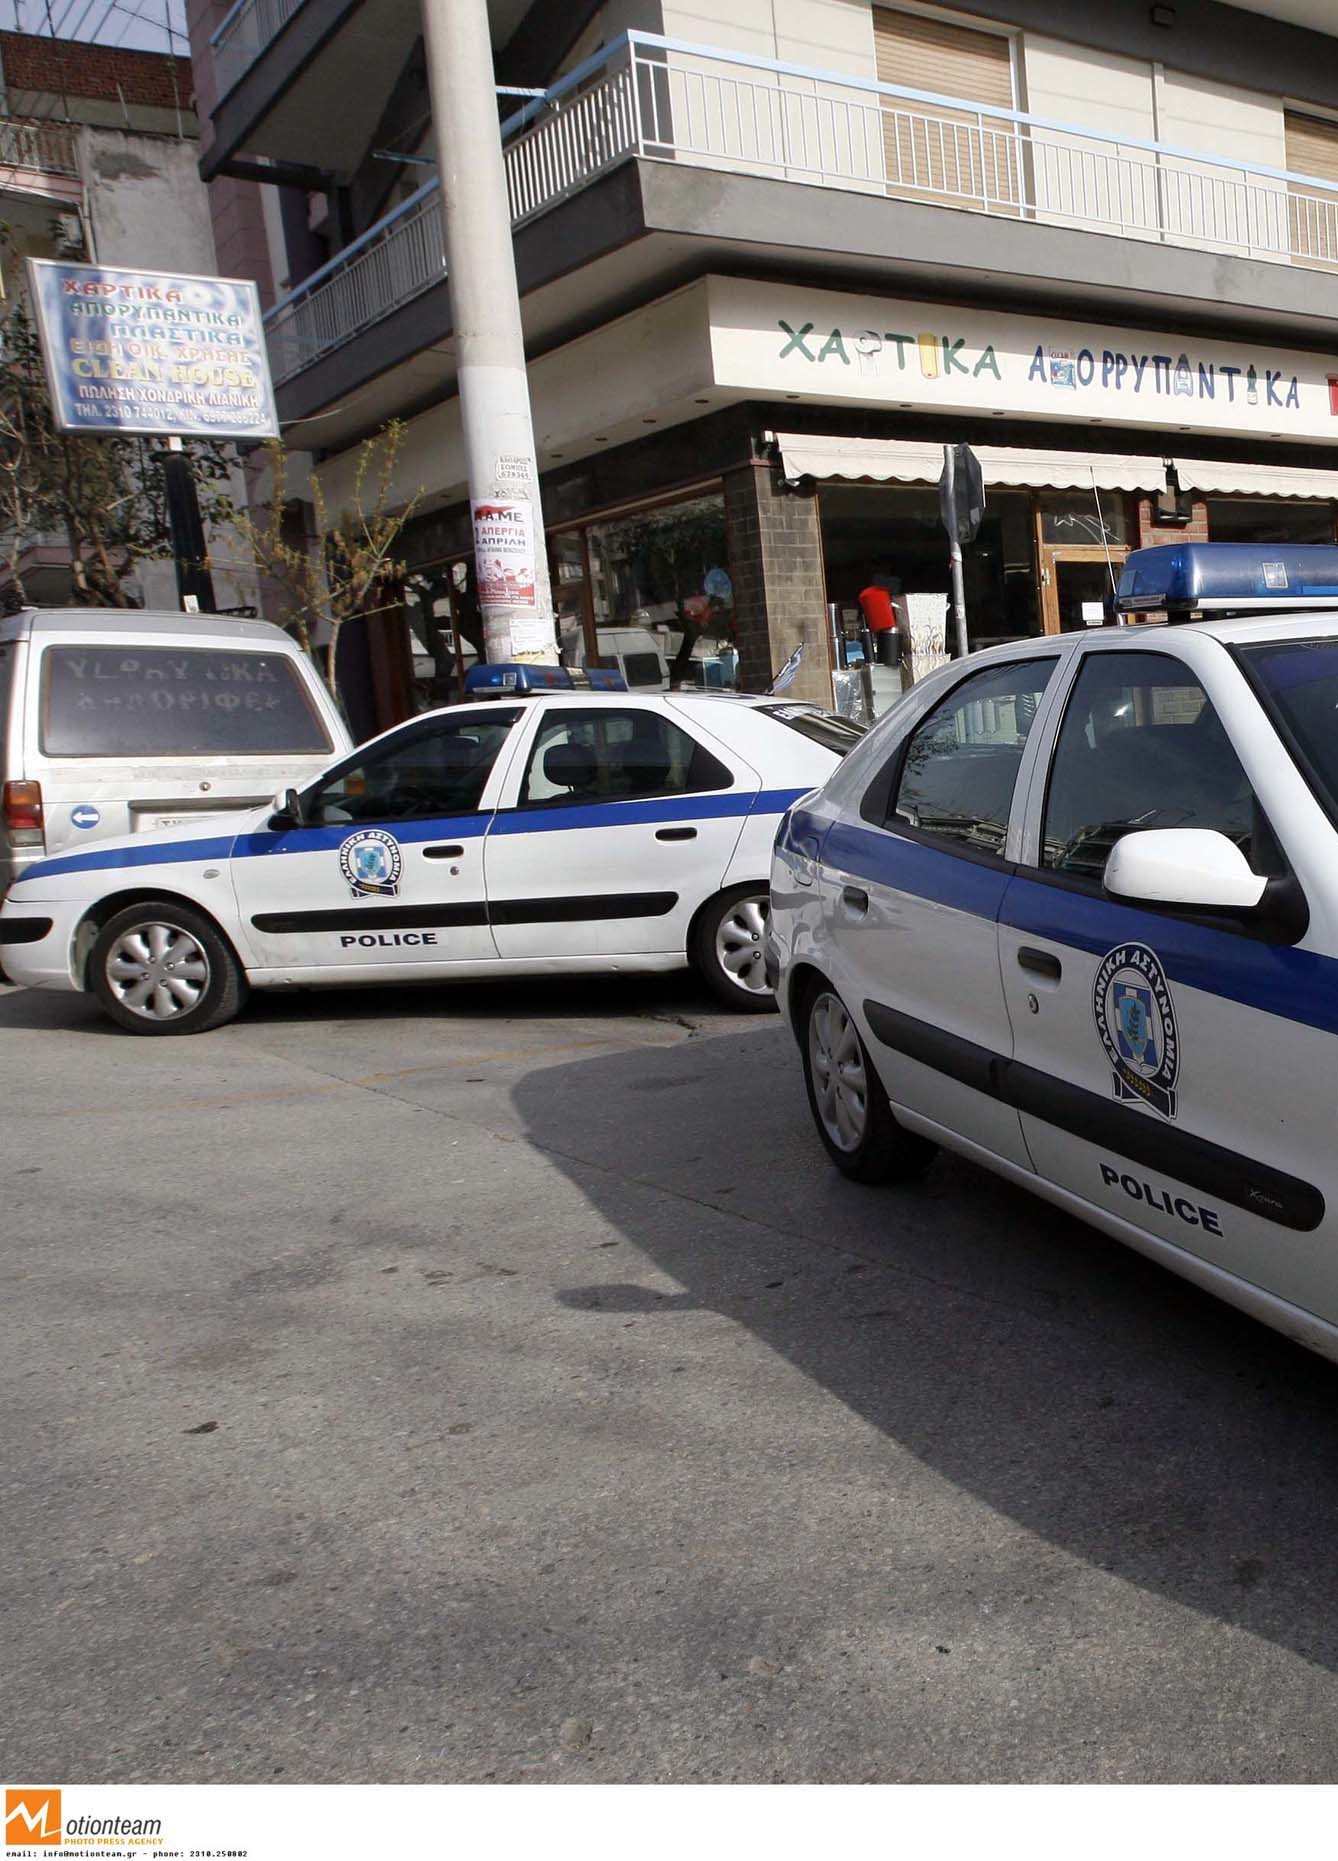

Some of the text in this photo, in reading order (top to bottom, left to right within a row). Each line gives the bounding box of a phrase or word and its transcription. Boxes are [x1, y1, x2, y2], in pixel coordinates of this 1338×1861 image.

[64, 279, 182, 302] ΧΑΡΤΙΚΑ
[111, 323, 243, 345] ΠΛΑΣΤΙΚΑ
[72, 358, 257, 389] CLEAN HOUSE
[79, 384, 135, 401] ΠΩΛΗΣΗ
[340, 932, 439, 948] POLICE
[1095, 949, 1178, 1081] ΕΛΛΗΝΙΚΗ ΑΣΤΥΝΟΜΙΑ
[1099, 1162, 1224, 1239] POLICE
